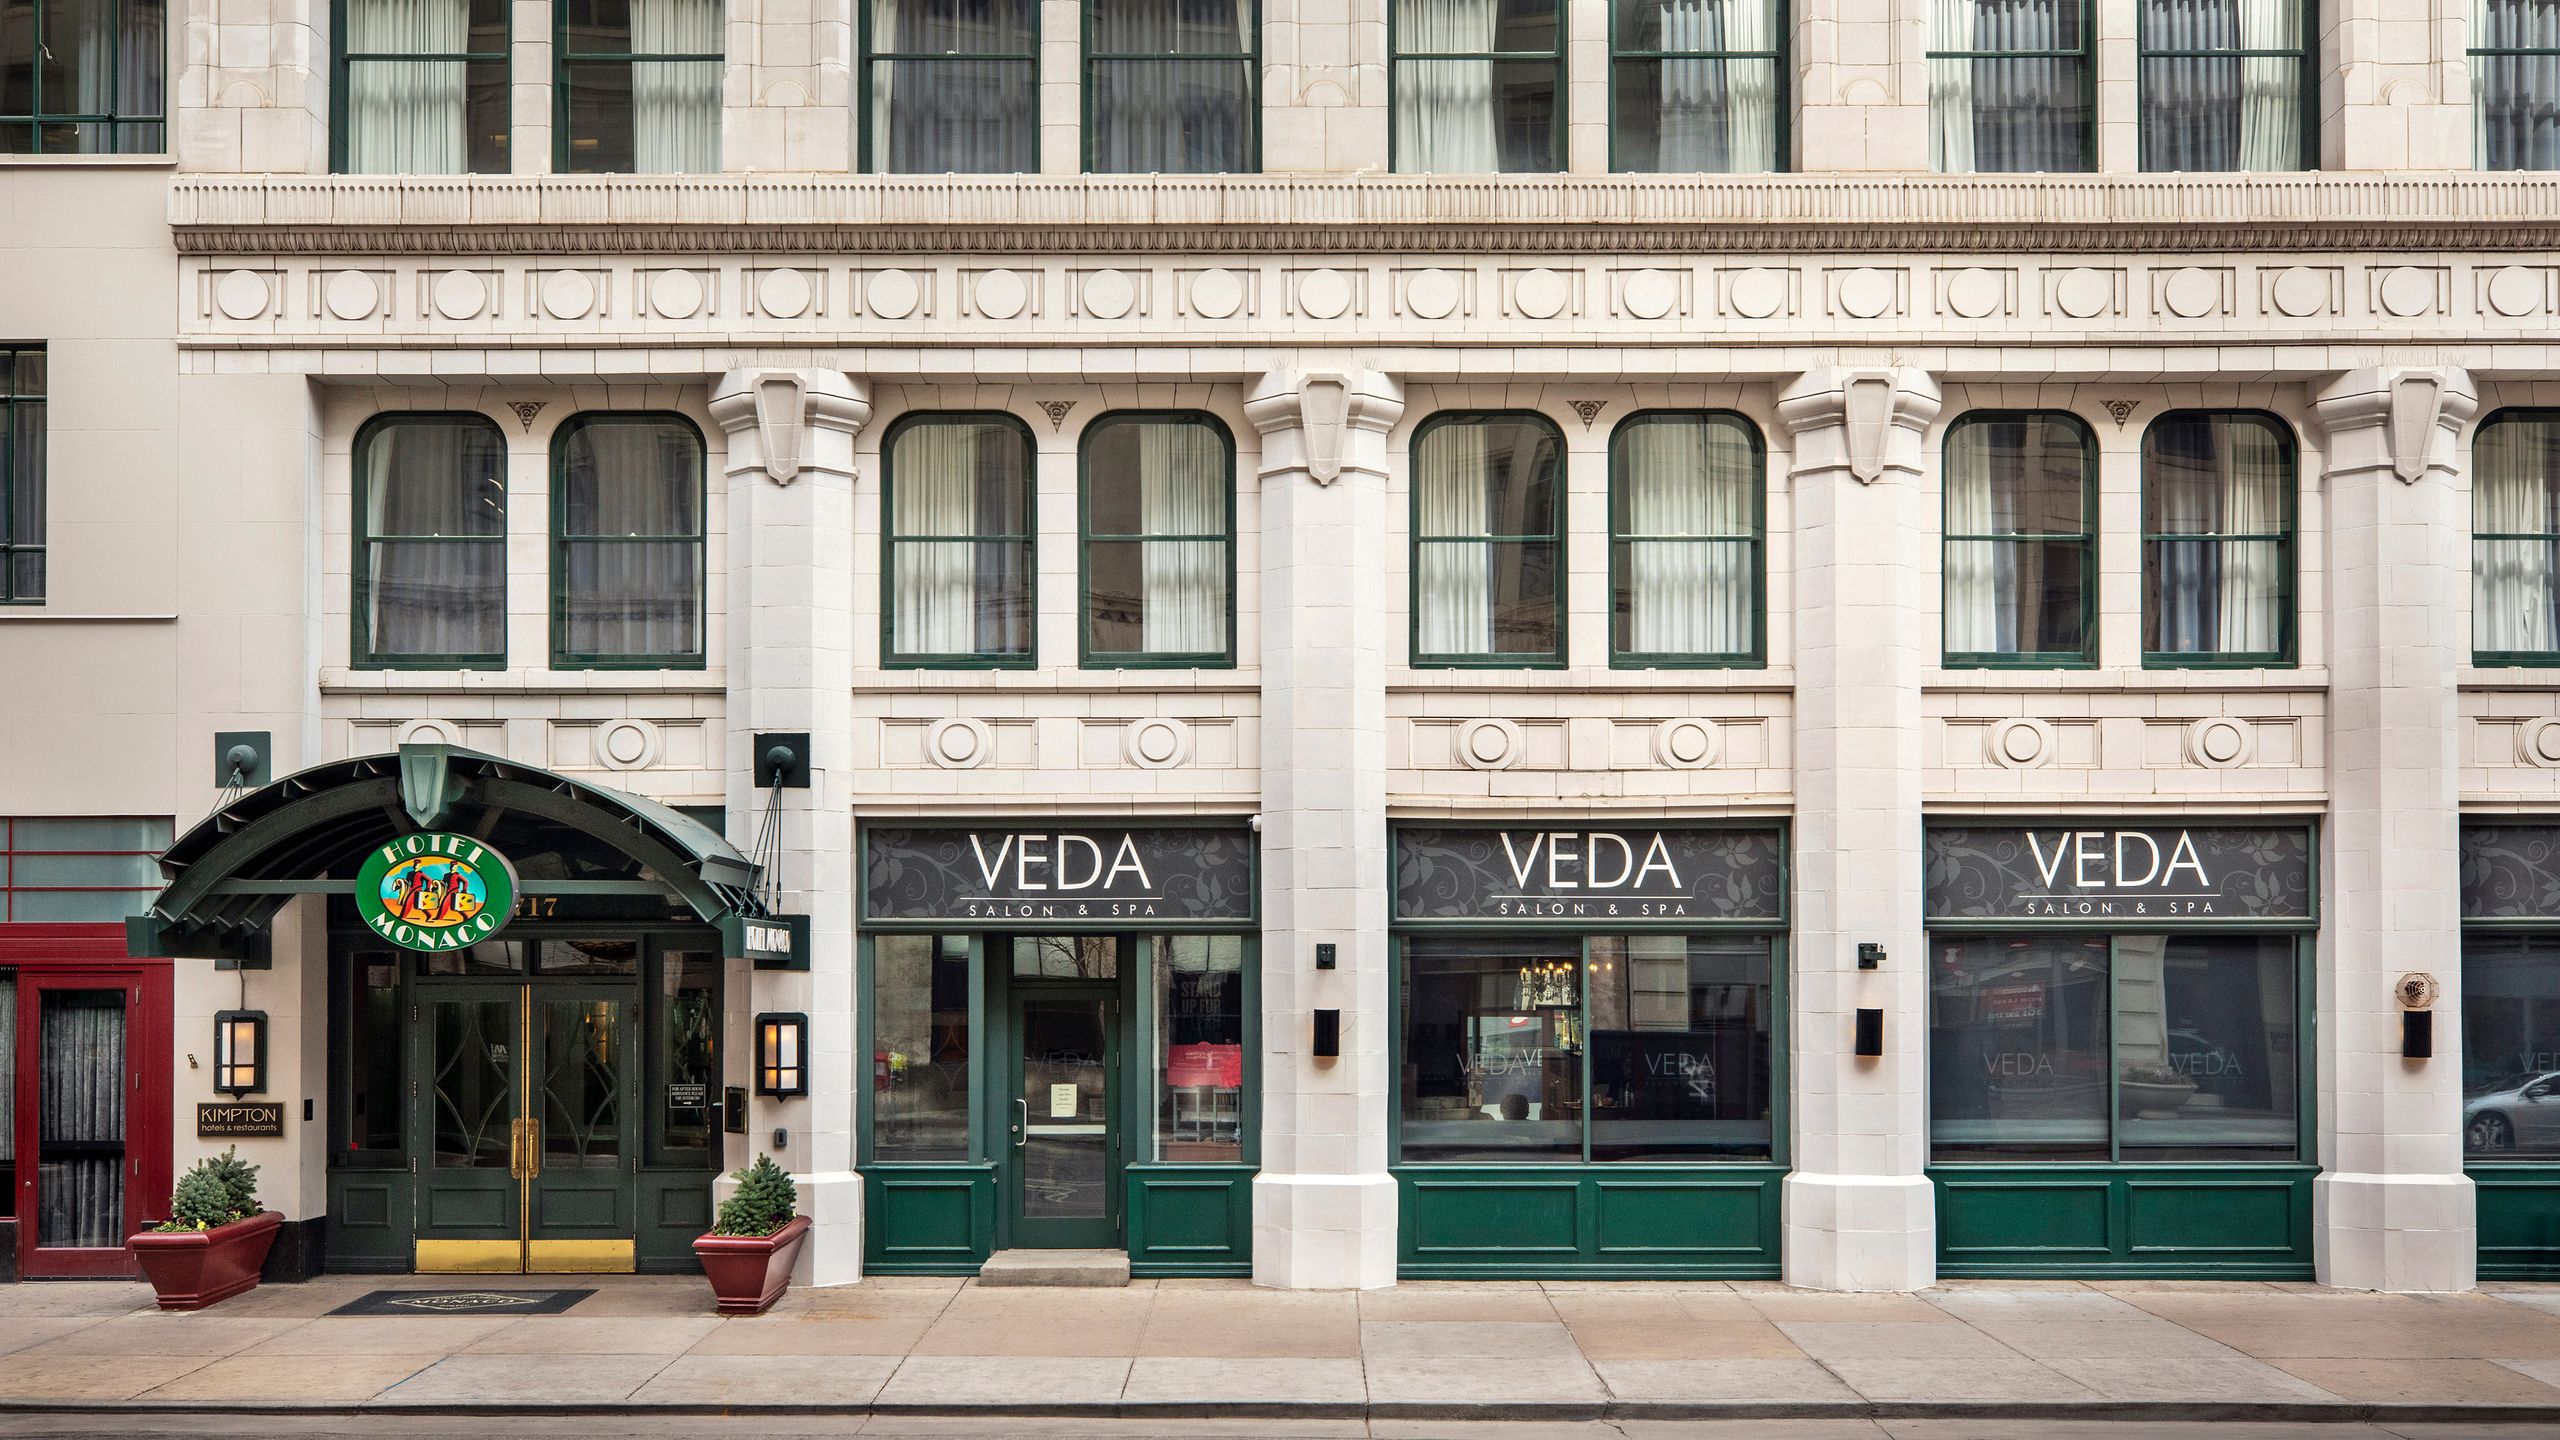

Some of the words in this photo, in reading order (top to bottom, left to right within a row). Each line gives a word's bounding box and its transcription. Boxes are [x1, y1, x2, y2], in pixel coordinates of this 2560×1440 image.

[382, 834, 484, 868] HOTEL
[970, 832, 1152, 892] VEDA
[1500, 831, 1683, 890] VEDA
[2026, 829, 2210, 889] VEDA
[969, 904, 1054, 917] SALON
[1078, 904, 1088, 916] &
[1112, 904, 1155, 916] SPA
[1500, 903, 1586, 916] SALON
[1608, 903, 1619, 915] &
[1642, 903, 1686, 915] SPA
[2027, 902, 2112, 915] SALON
[2136, 902, 2147, 914] &
[2169, 902, 2214, 914] SPA
[370, 912, 495, 949] MONACO
[1456, 1053, 1527, 1076] VEDA
[1644, 1053, 1716, 1075] VEDA
[1983, 1053, 2054, 1075] VEDA
[2170, 1052, 2242, 1075] VEDA
[201, 1108, 276, 1122] KIMPTON
[201, 1124, 225, 1132] hotels
[226, 1124, 232, 1132] &
[233, 1124, 278, 1132] restaurants
